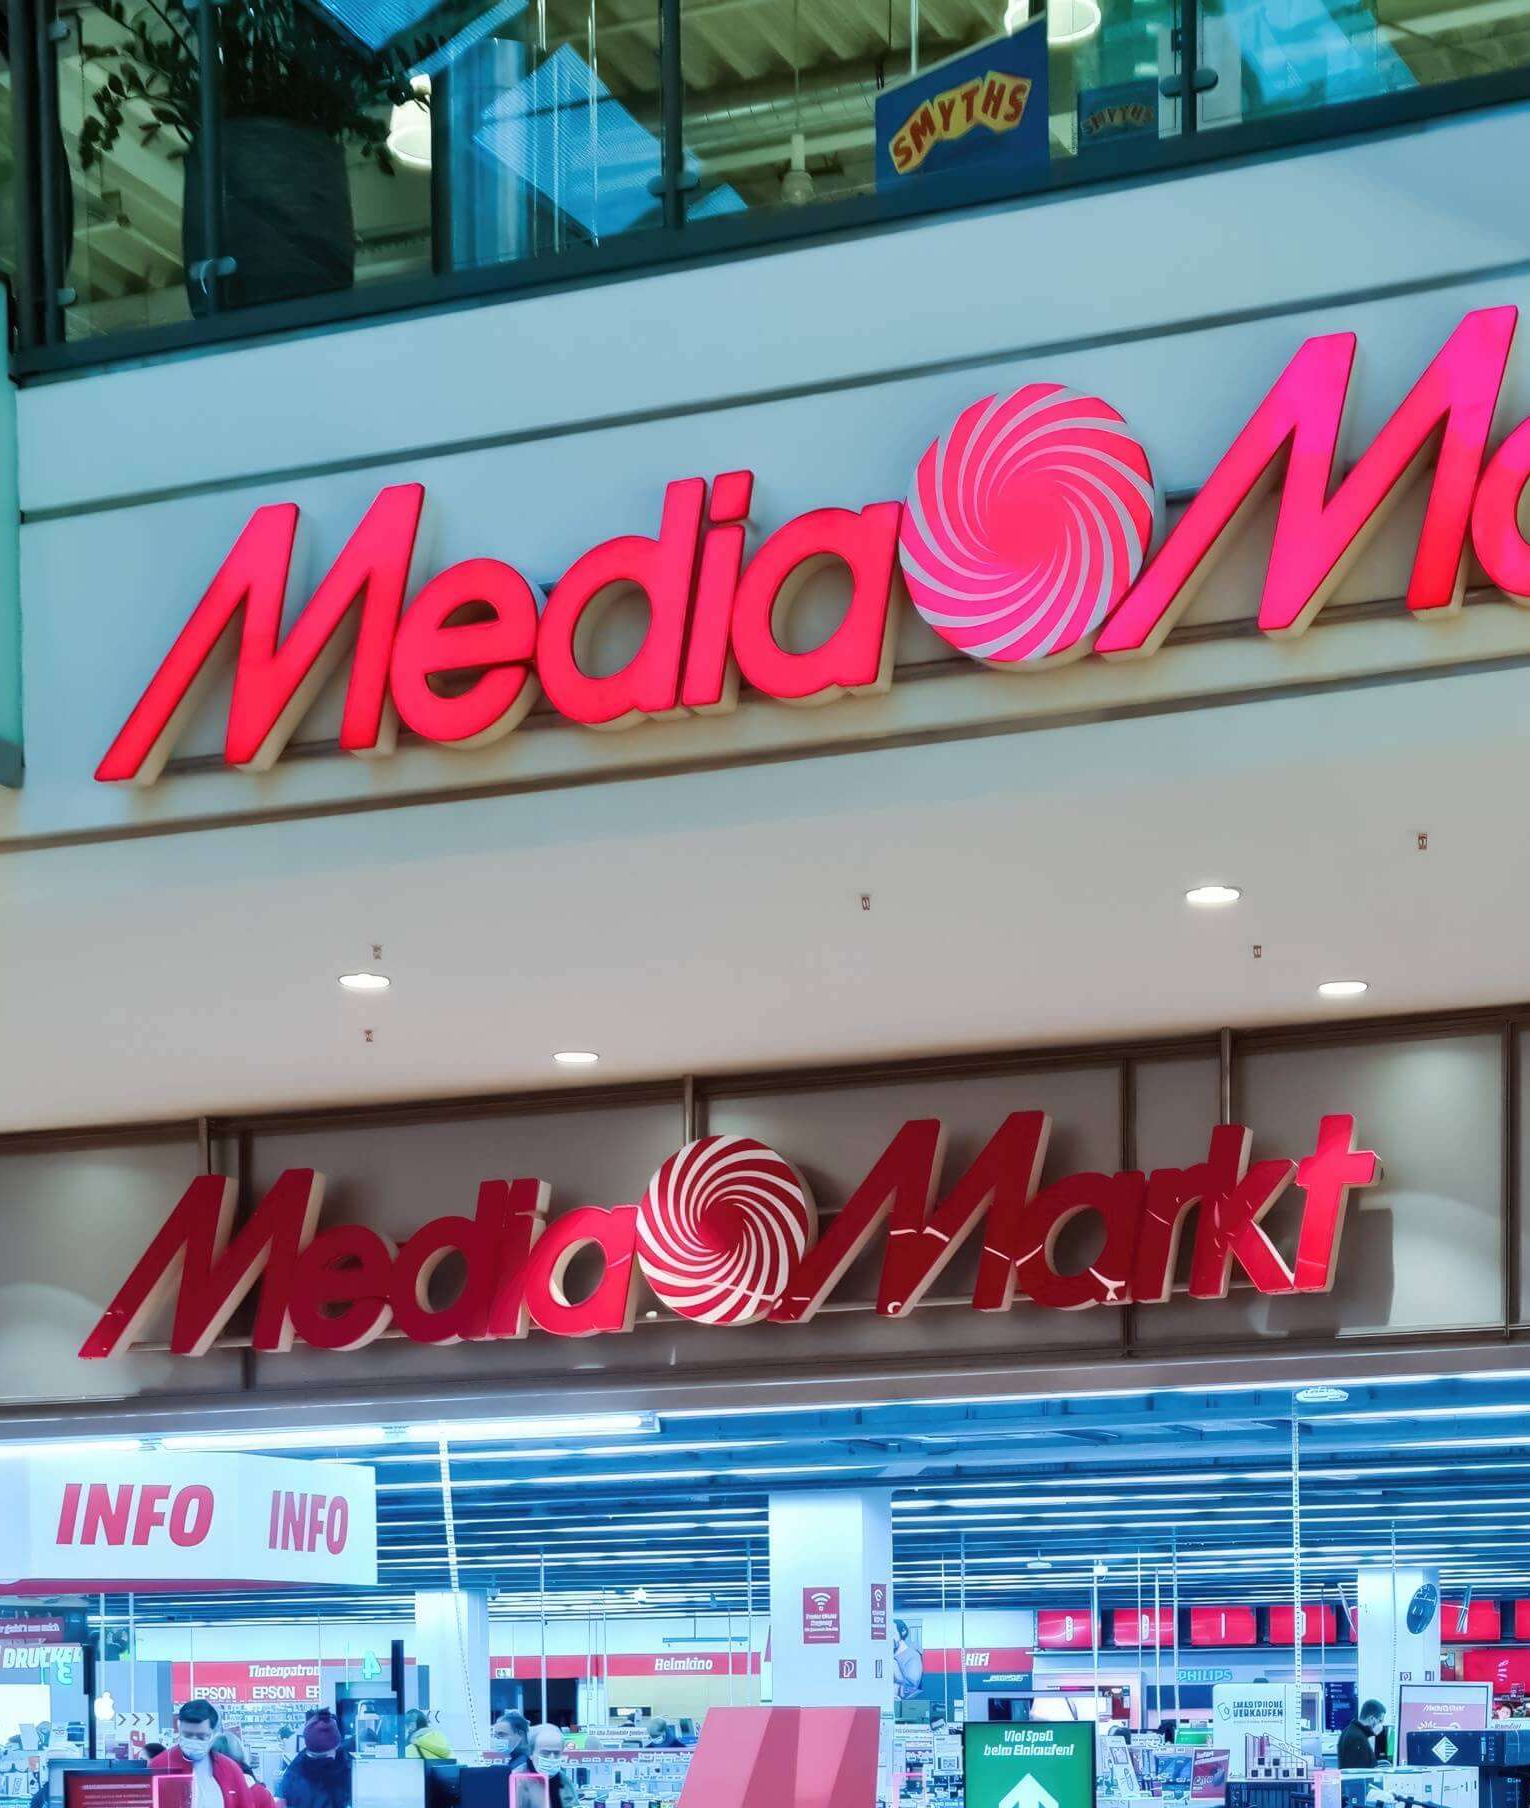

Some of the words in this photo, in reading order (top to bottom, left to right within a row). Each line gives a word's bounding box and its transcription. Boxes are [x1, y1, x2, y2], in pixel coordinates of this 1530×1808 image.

[890, 78, 1028, 171] SMYTHS
[92, 469, 905, 783] Media
[79, 1164, 638, 1359] Media
[771, 1110, 1377, 1322] Markt
[55, 1482, 216, 1547] INFO
[268, 1489, 350, 1556] INFO
[653, 1657, 714, 1671] Heimkino
[965, 1652, 990, 1667] HiFi
[1178, 1668, 1233, 1681] PHILIPS
[193, 1686, 237, 1700] EPSON
[252, 1685, 296, 1699] EPSON
[1232, 1708, 1284, 1717] VERKAUFEN
[1004, 1730, 1026, 1743] Viel
[1026, 1730, 1054, 1745] Spaß
[983, 1743, 1012, 1756] beim
[1013, 1743, 1075, 1756] Einkaufen!
